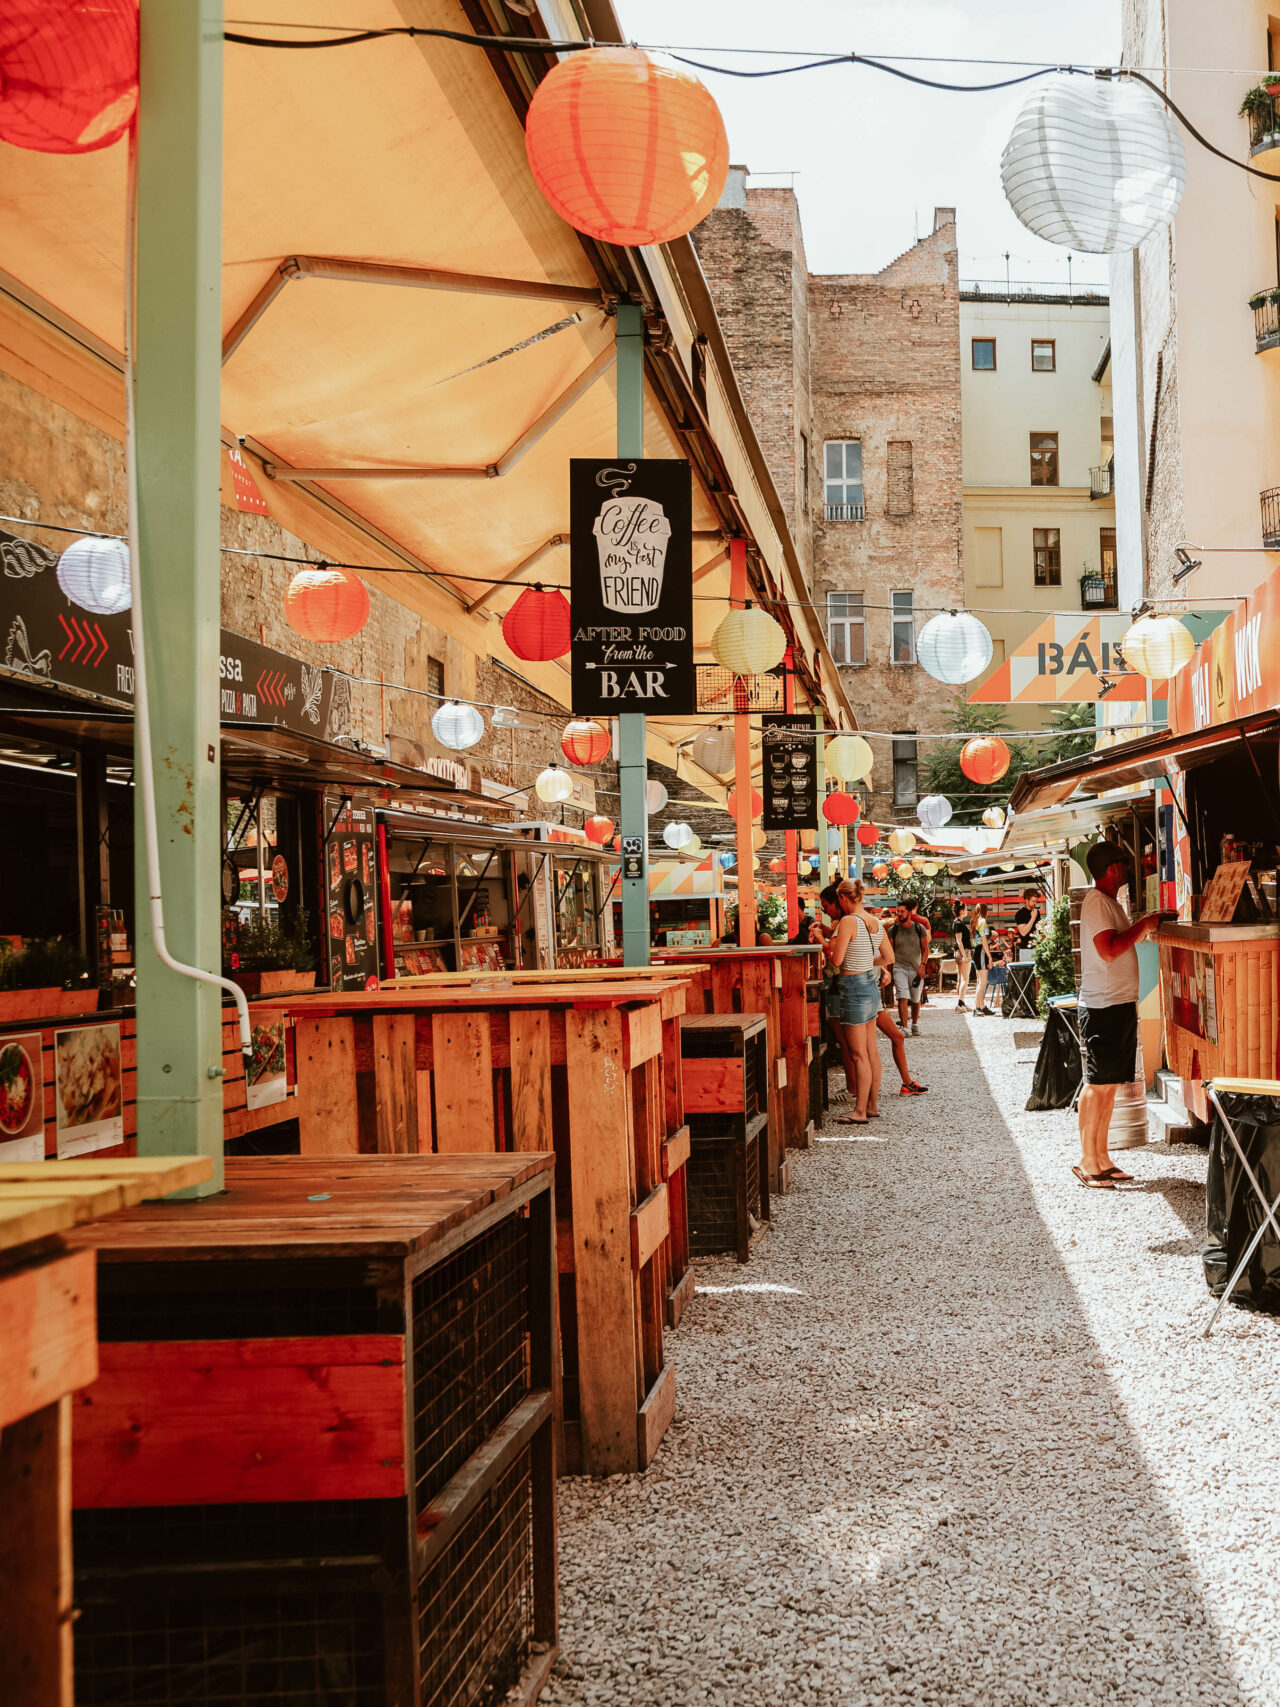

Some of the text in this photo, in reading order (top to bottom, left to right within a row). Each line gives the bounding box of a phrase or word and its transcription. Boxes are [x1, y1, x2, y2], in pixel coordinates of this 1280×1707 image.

[600, 503, 662, 547] Coffee
[604, 543, 663, 574] my best
[603, 576, 659, 607] FRIEND
[573, 626, 687, 642] AFTER FOOD
[601, 644, 655, 664] from the
[1235, 612, 1262, 701] WOK
[600, 670, 670, 698] BAR
[221, 688, 236, 714] PIZZA
[242, 693, 258, 718] PASTA
